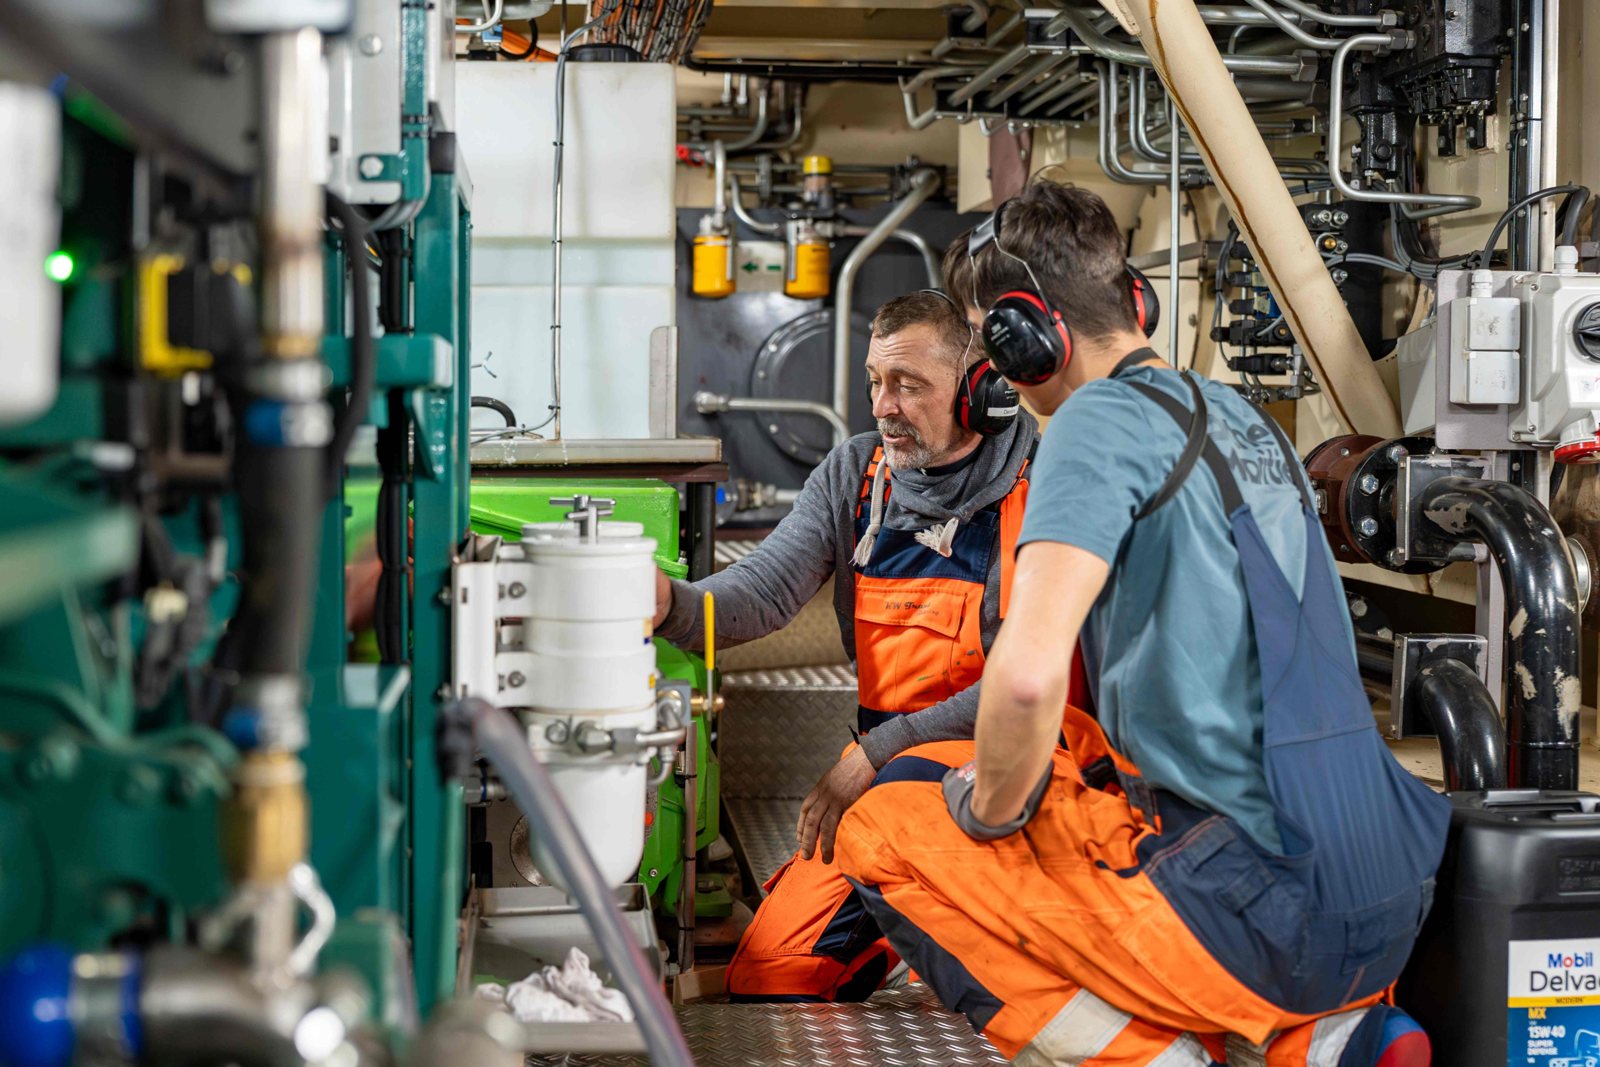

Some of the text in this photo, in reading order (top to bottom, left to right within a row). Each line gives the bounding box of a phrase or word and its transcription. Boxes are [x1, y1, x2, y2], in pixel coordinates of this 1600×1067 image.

[1548, 952, 1593, 968] Mobil
[1530, 970, 1600, 992] Delva
[1528, 1007, 1547, 1019] MX
